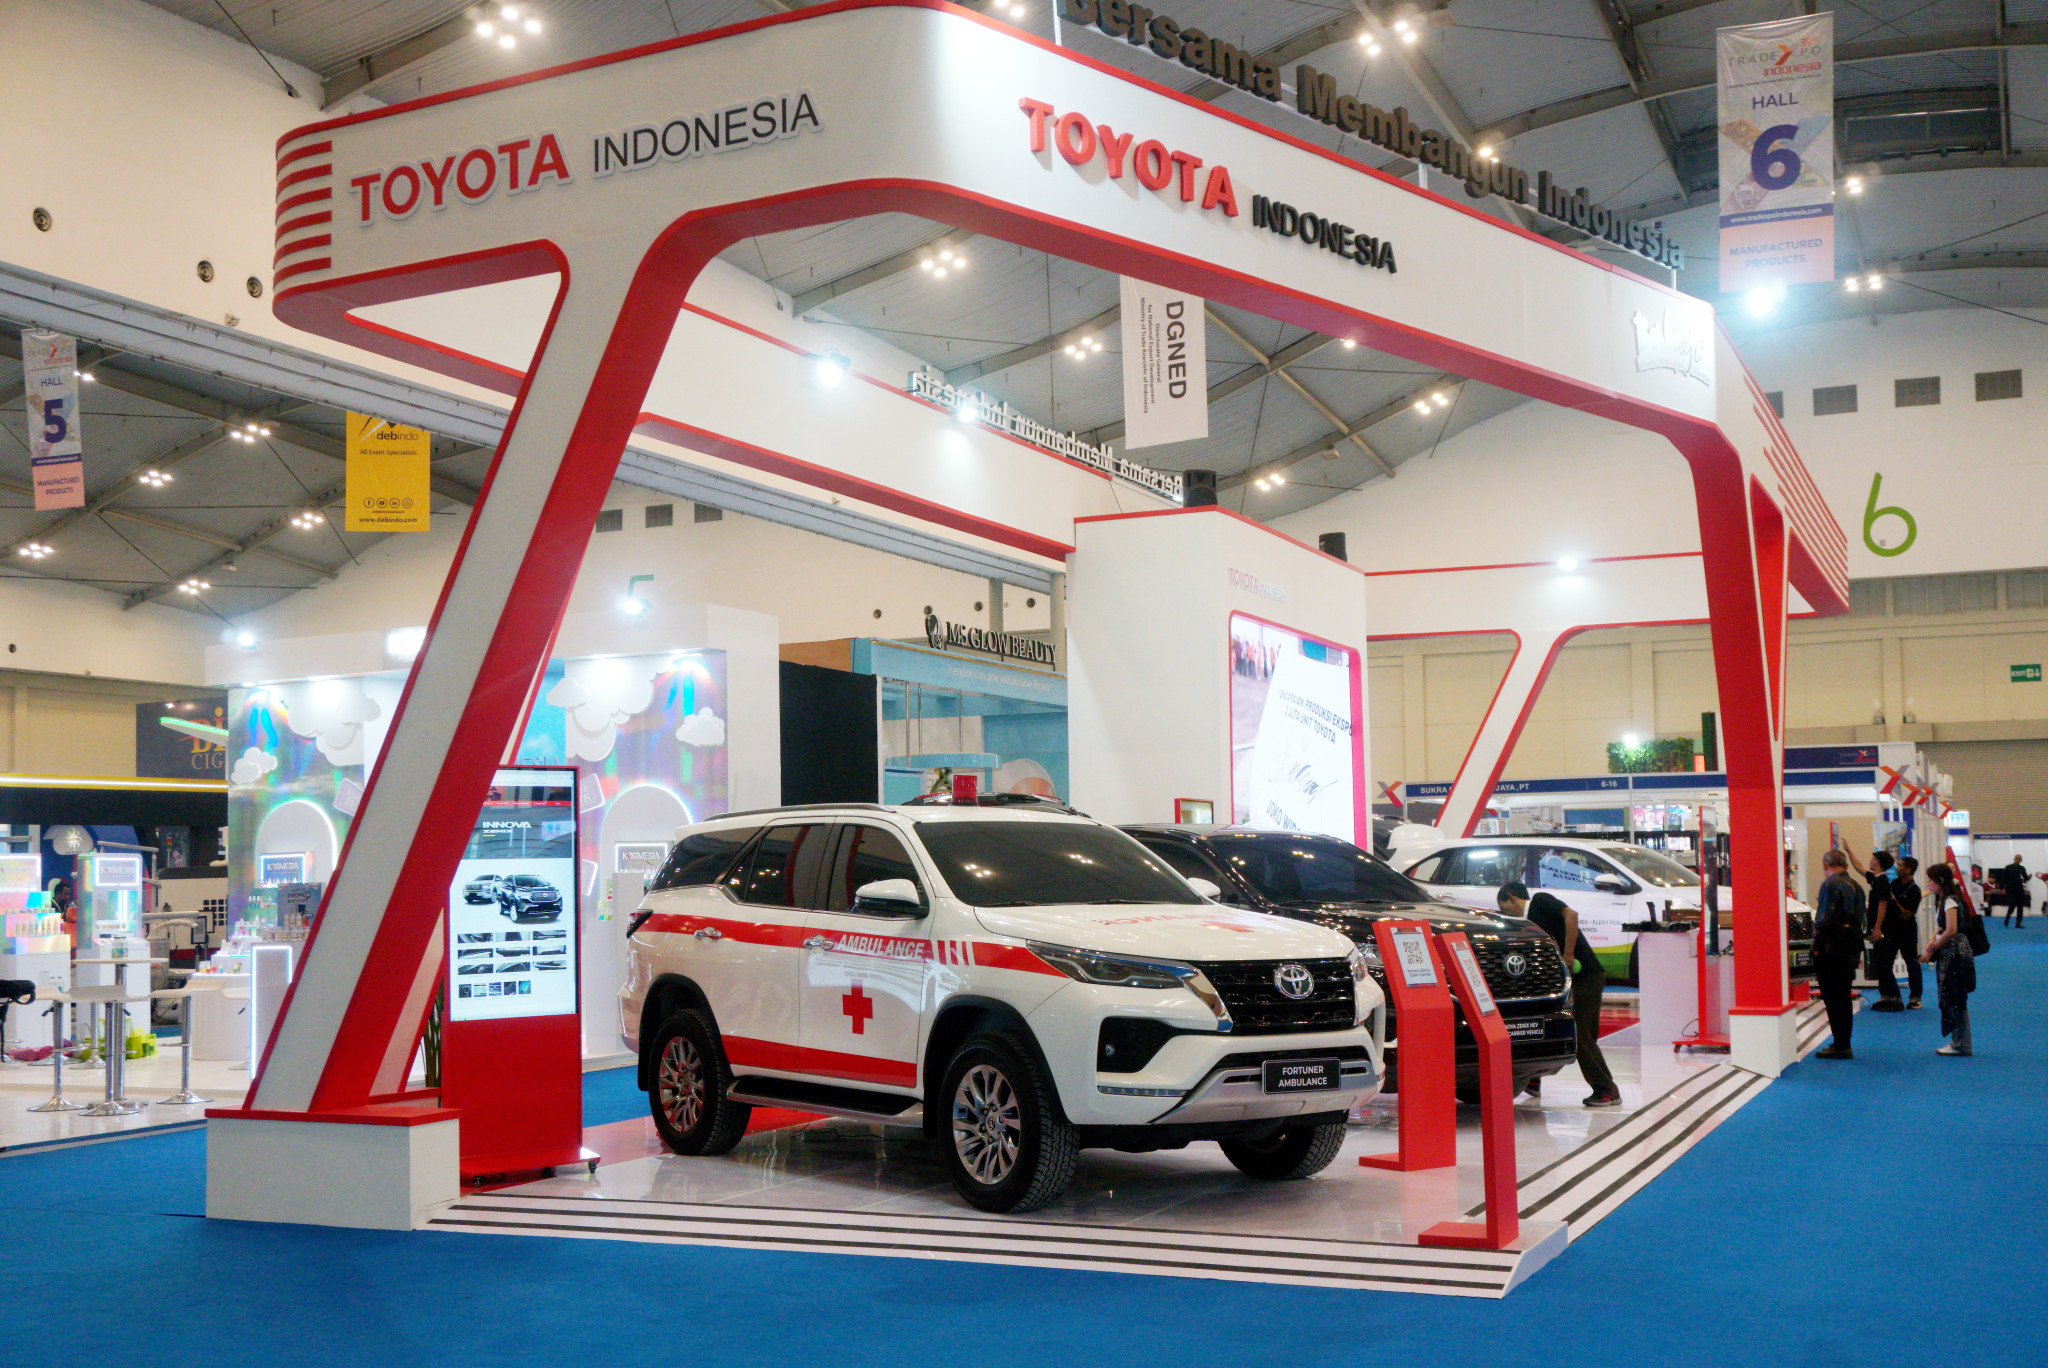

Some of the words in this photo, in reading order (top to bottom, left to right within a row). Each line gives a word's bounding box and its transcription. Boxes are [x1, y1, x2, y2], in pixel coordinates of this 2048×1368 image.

[1752, 92, 1799, 109] HALL
[351, 133, 570, 221] TOYOTA
[593, 92, 820, 174] INDONESIA
[1296, 64, 1529, 204] Membangun
[1538, 171, 1685, 270] Indonesia
[1751, 124, 1801, 190] 6
[1018, 97, 1239, 217] TOYOTA
[1252, 194, 1398, 274] INDONESIA
[1730, 238, 1823, 256] MANUFACTURED
[1745, 254, 1806, 268] PRODUCTS
[1166, 300, 1187, 399] DGNED
[40, 377, 64, 387] HALL
[44, 399, 67, 443] 5
[376, 431, 419, 441] debindo
[1863, 472, 1917, 557] 6
[945, 621, 967, 645] MS
[968, 627, 1009, 654] GLOW
[1010, 635, 1056, 663] BEAUTY
[1305, 700, 1333, 722] PRODUKSI
[1313, 719, 1336, 744] TOYOTA
[1420, 786, 1447, 794] SUKRA
[1601, 780, 1618, 788] 6-16
[1266, 800, 1282, 826] JOKO
[836, 934, 925, 960] AMBULANCE
[1278, 1077, 1328, 1087] AMBULANCE
[1282, 1066, 1324, 1075] FORTUNER
